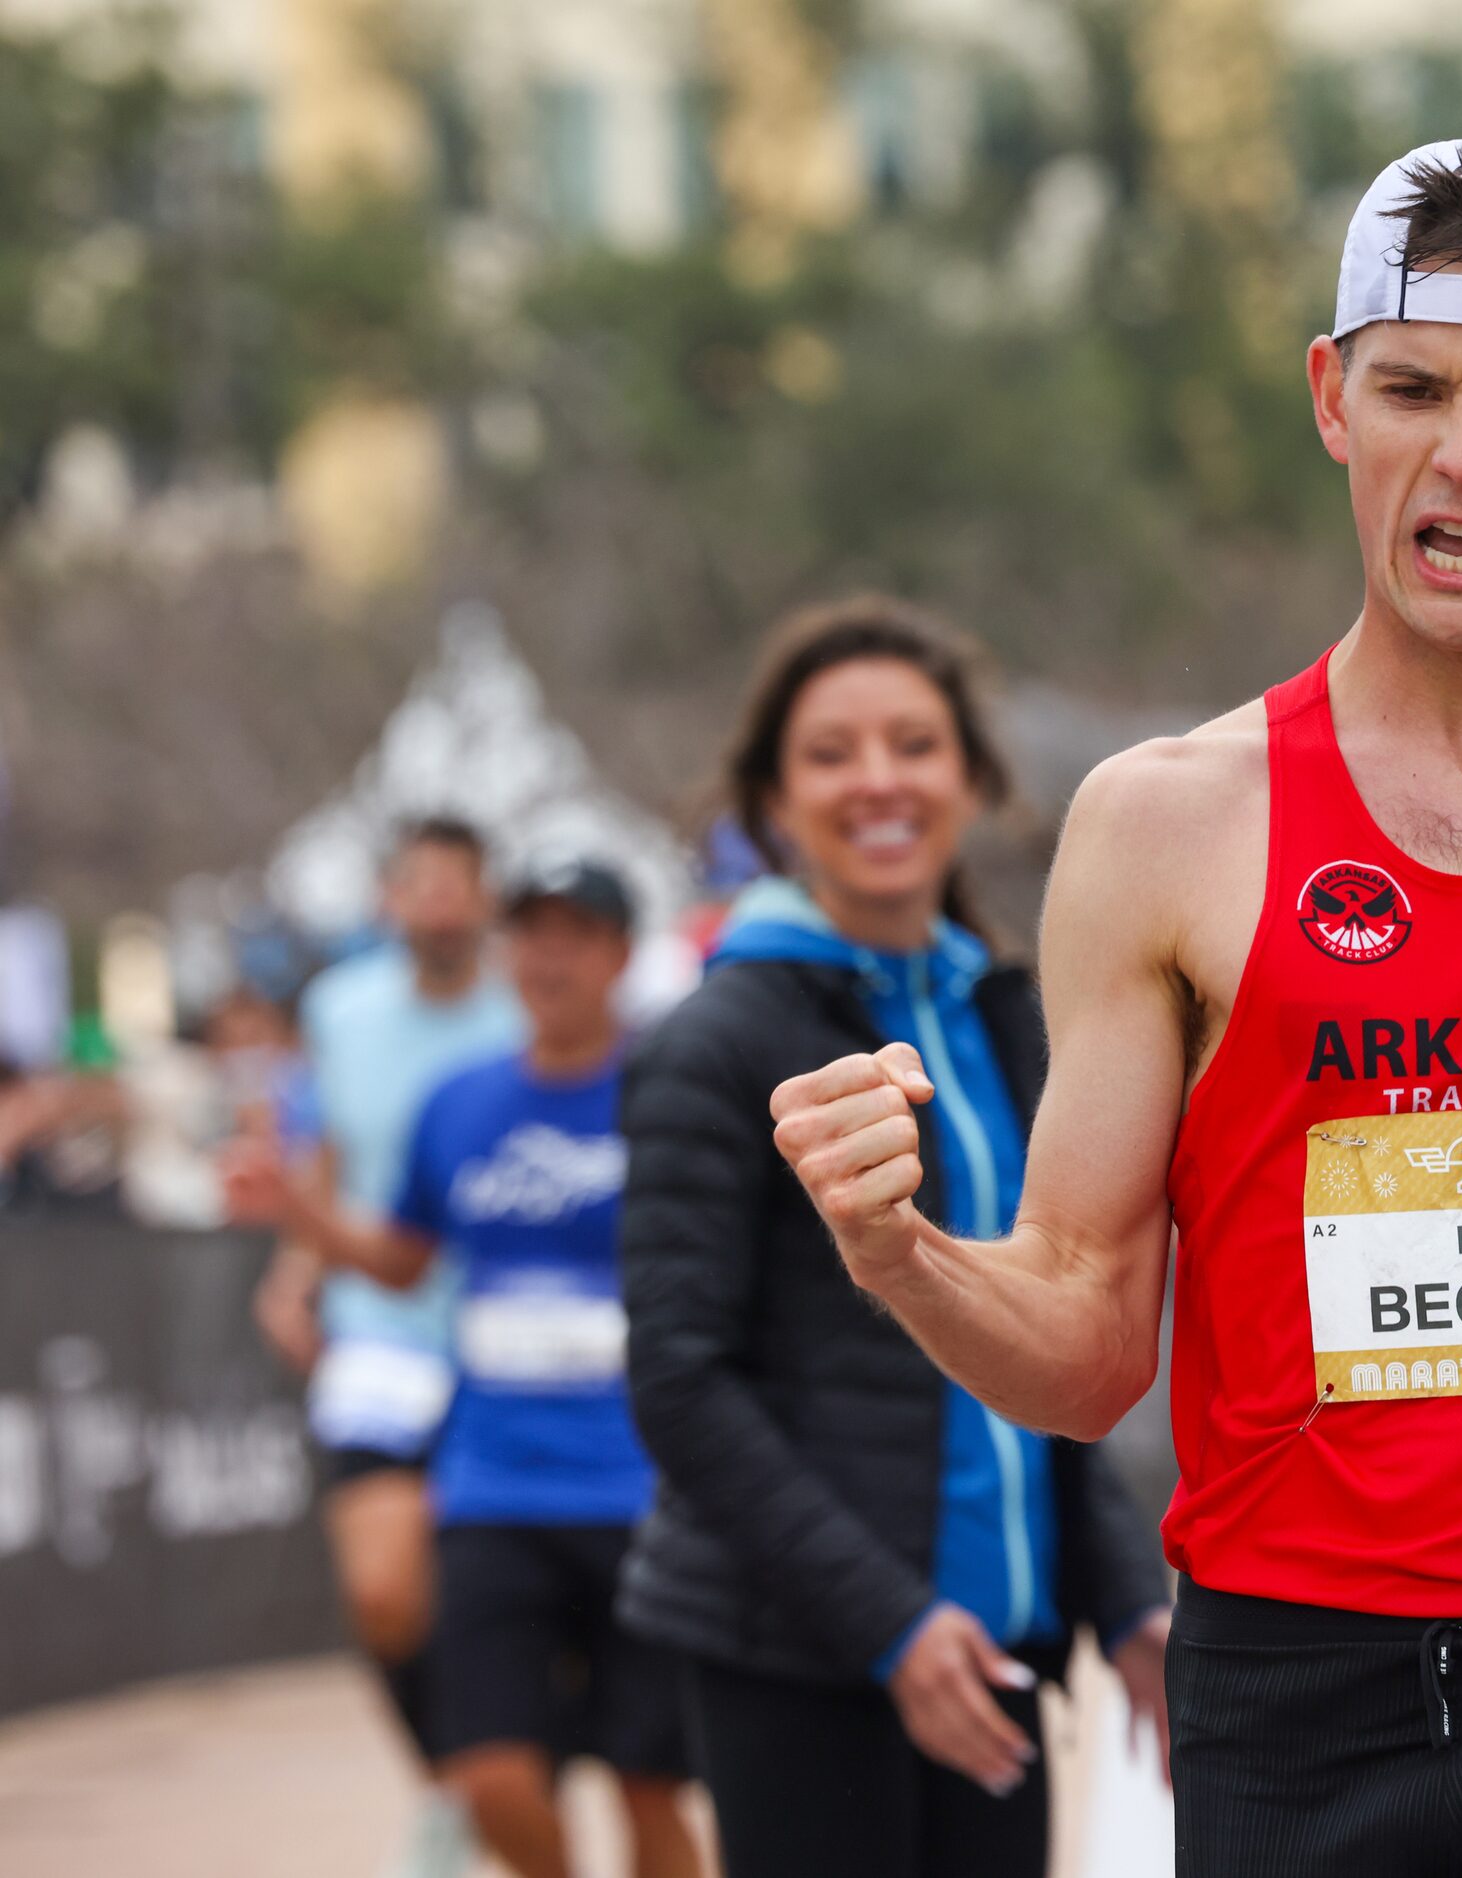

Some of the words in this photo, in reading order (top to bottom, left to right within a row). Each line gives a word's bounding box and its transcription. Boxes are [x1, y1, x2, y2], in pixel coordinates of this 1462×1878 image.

[1319, 867, 1387, 888] ARKANSAS
[1323, 940, 1362, 959] TRACK
[1366, 941, 1394, 959] CLUB
